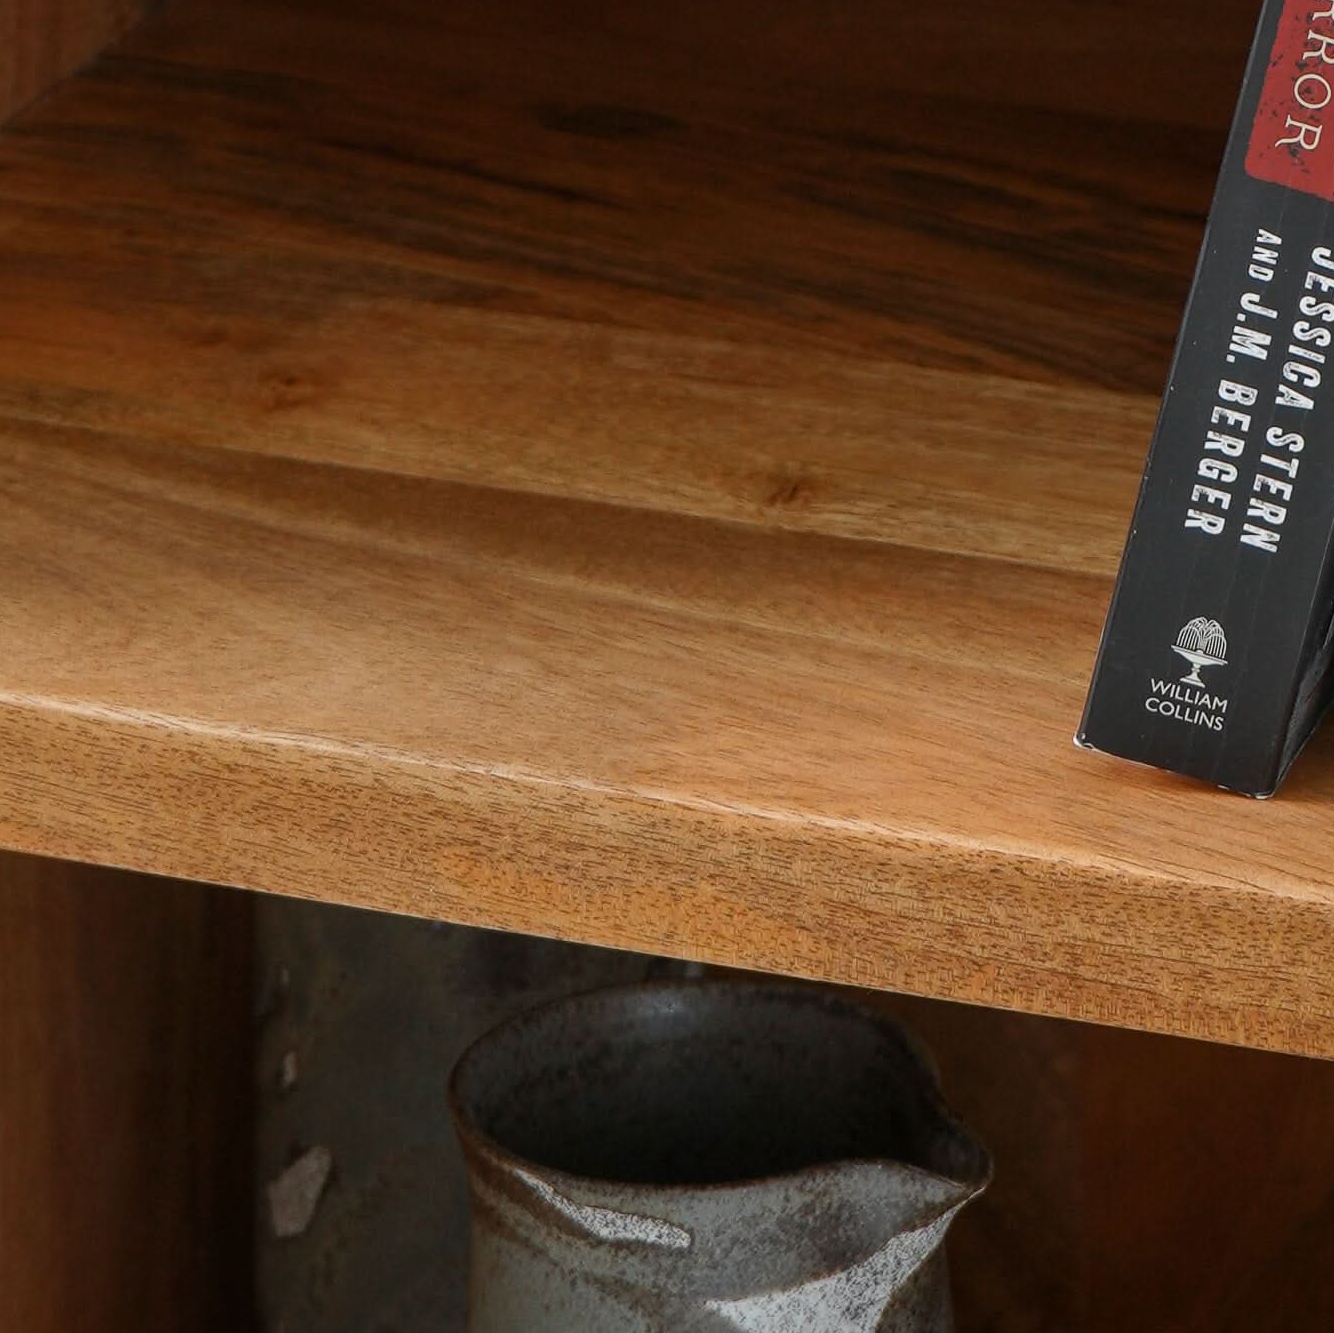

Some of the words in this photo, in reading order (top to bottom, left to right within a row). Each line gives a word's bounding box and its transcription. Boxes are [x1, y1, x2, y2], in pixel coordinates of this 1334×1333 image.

[1247, 228, 1283, 283] AND
[1225, 292, 1277, 362] J.M.
[1184, 379, 1259, 536] BERGER
[1240, 426, 1305, 554] STERN
[1145, 697, 1224, 731] COLLINS
[1150, 677, 1228, 714] WILLIAM
